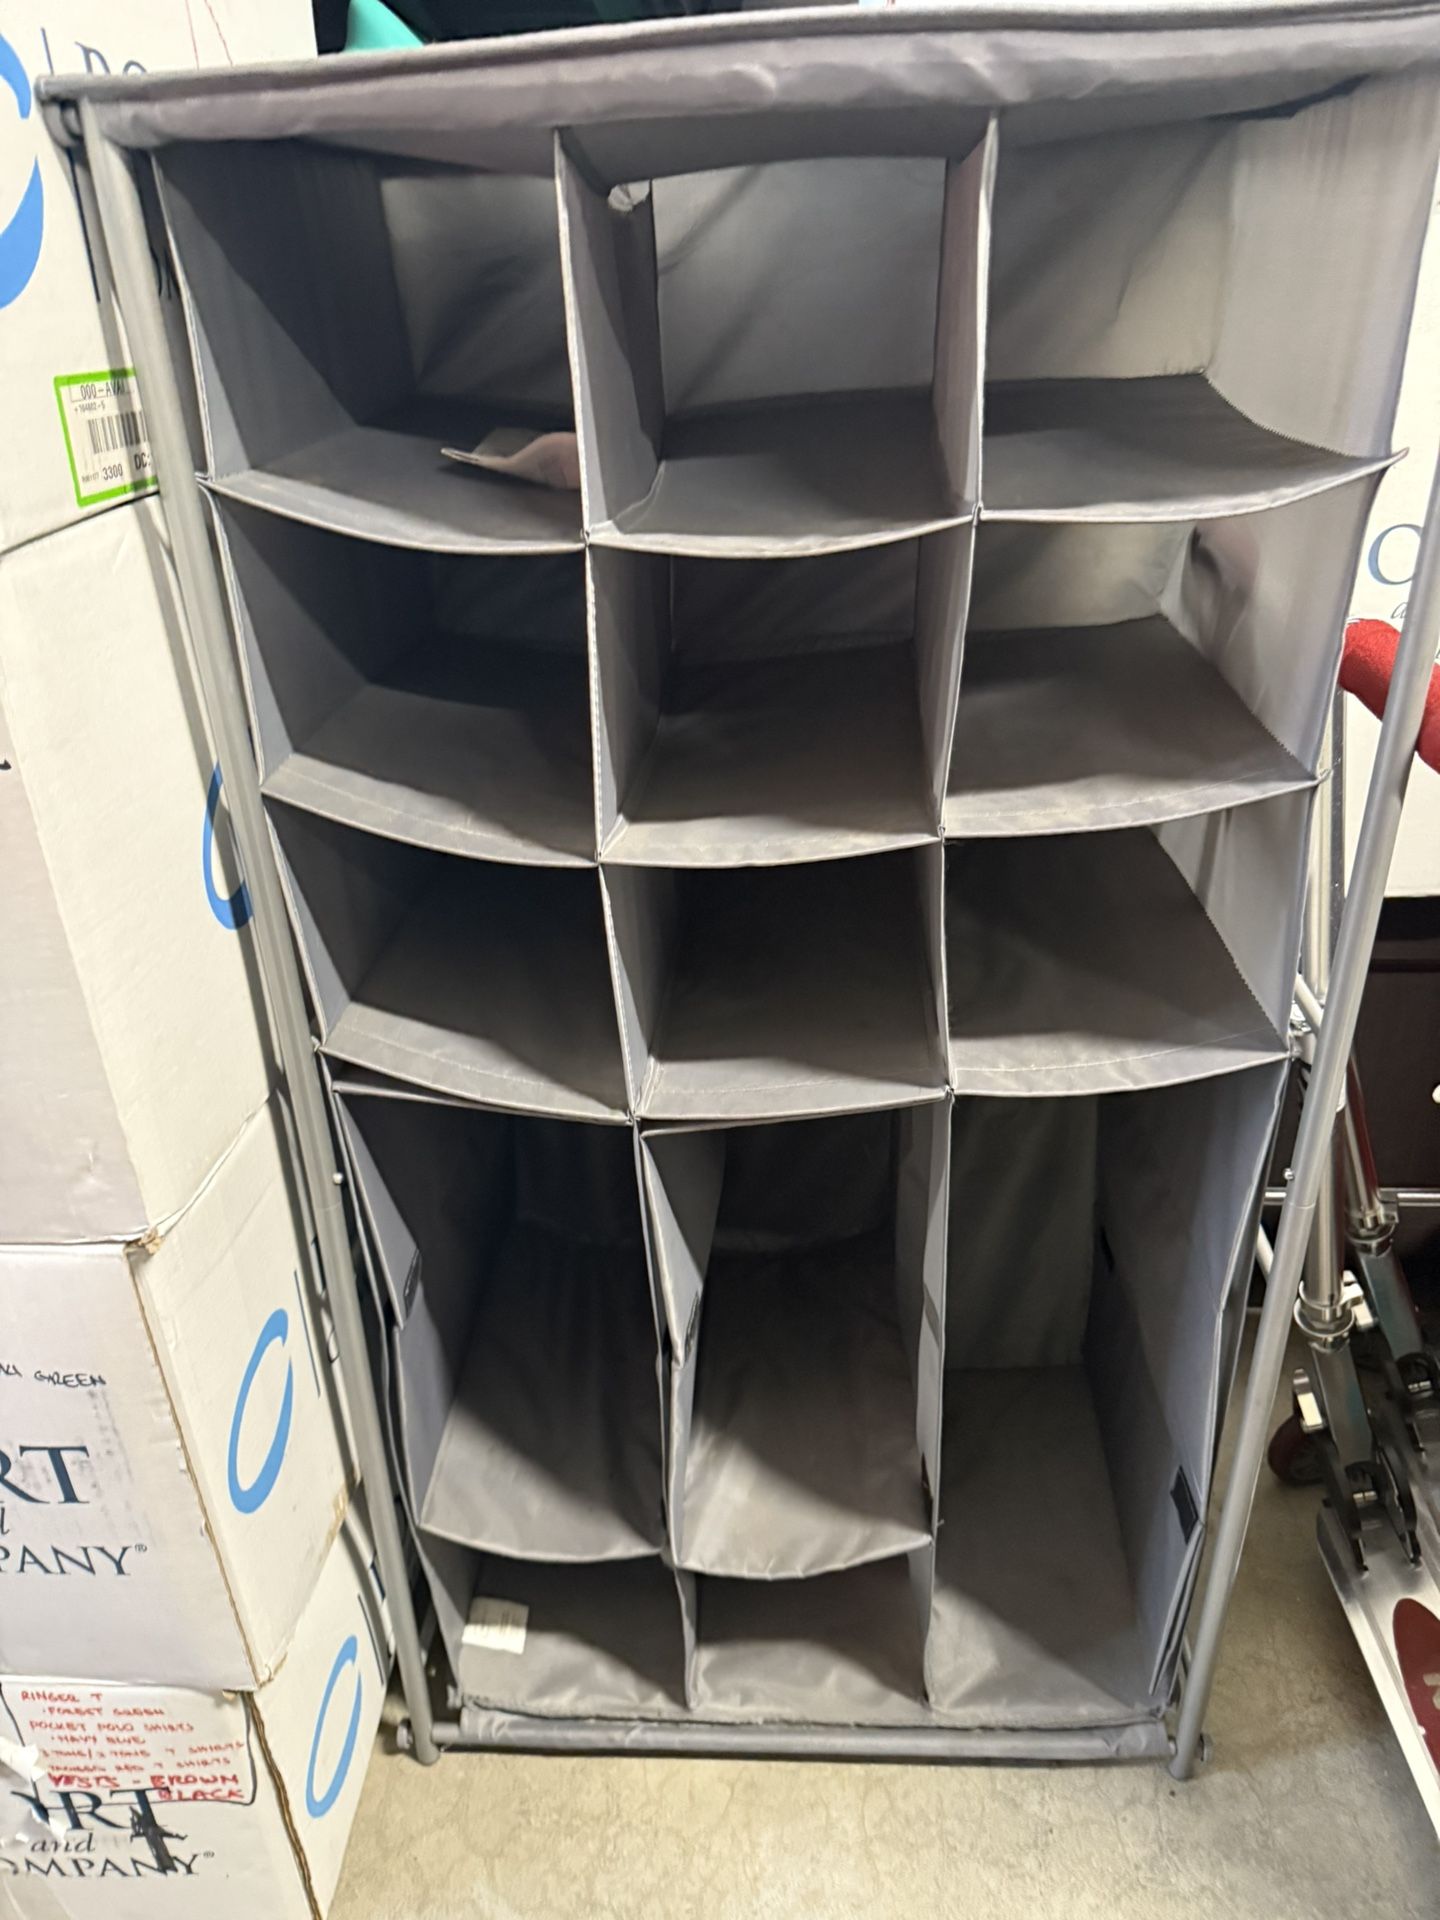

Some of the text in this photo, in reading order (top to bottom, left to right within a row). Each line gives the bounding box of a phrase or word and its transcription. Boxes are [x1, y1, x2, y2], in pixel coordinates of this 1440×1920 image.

[102, 463, 124, 481] 3300
[33, 1369, 107, 1388] GREEN
[21, 1690, 80, 1702] RINGER
[48, 1772, 121, 1788] VESTS
[31, 1832, 96, 1853] and
